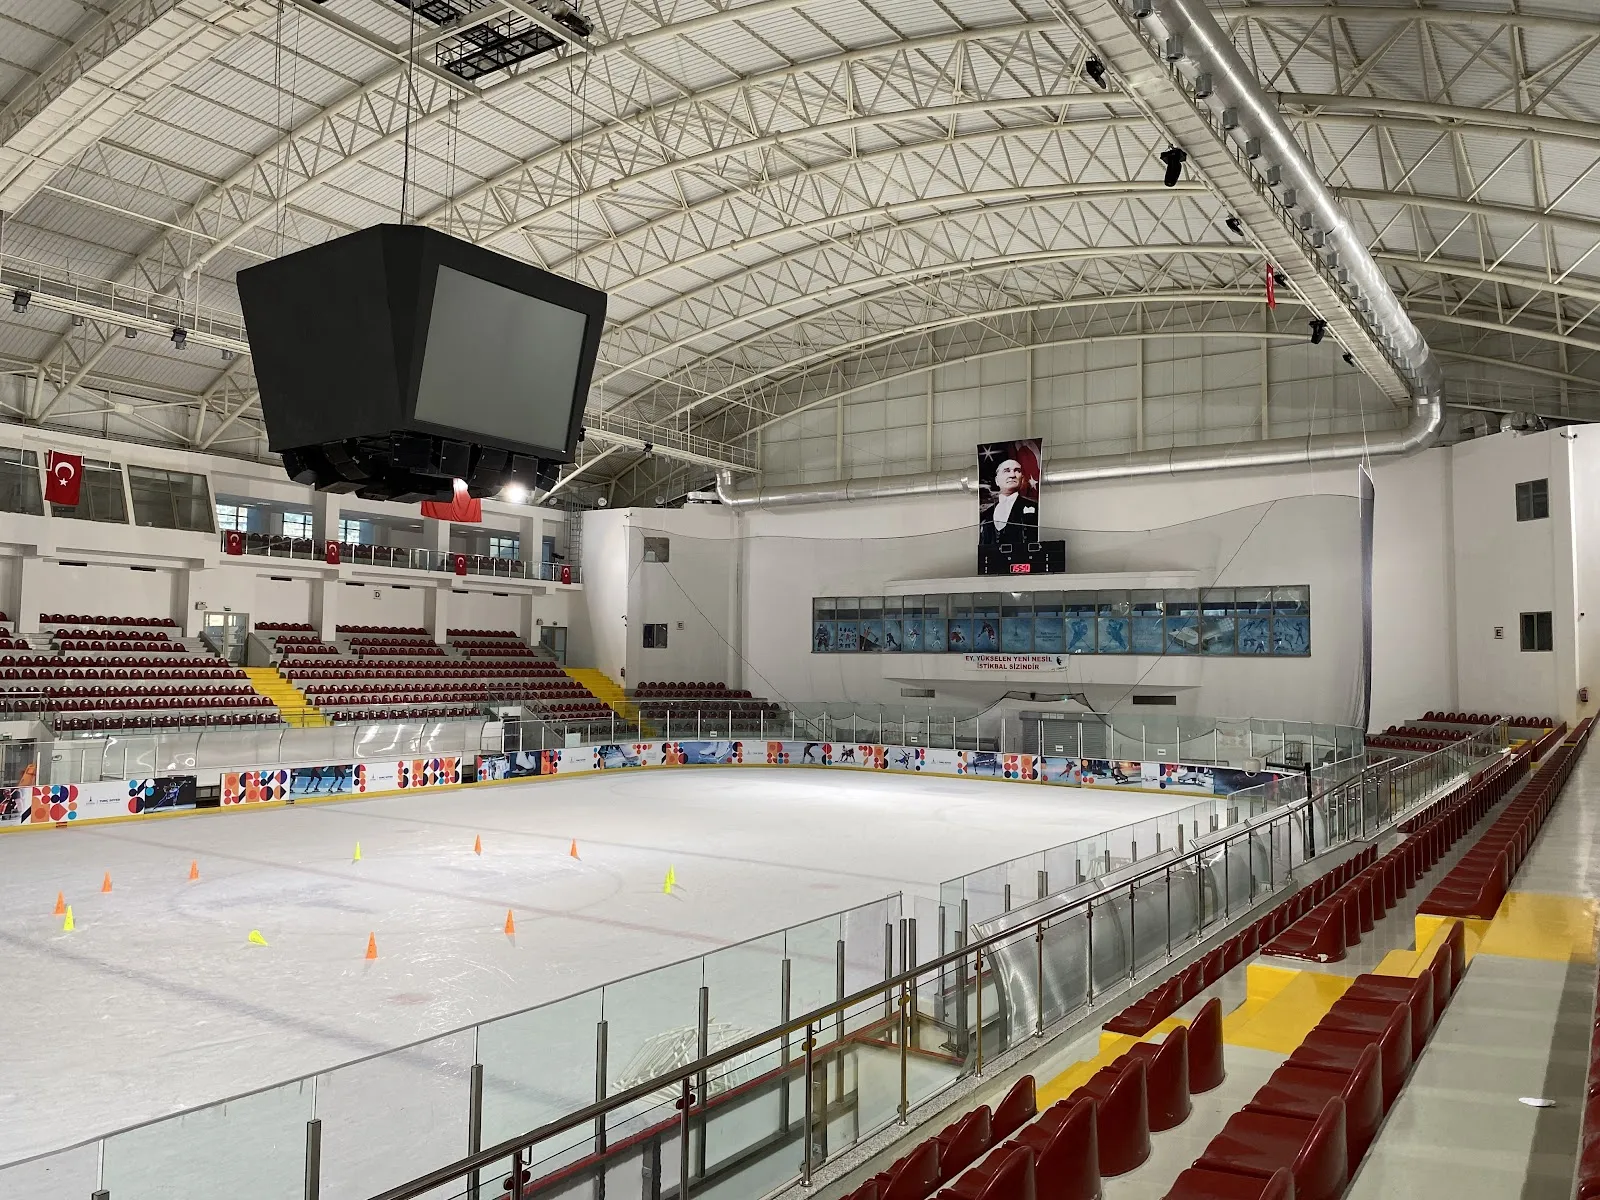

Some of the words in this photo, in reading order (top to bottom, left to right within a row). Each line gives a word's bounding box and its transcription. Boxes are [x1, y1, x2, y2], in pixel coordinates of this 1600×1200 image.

[976, 654, 1012, 662] YÜKSELEN
[977, 662, 1008, 670] İSTİKBAL
[1009, 662, 1040, 670] SİZİNDİR
